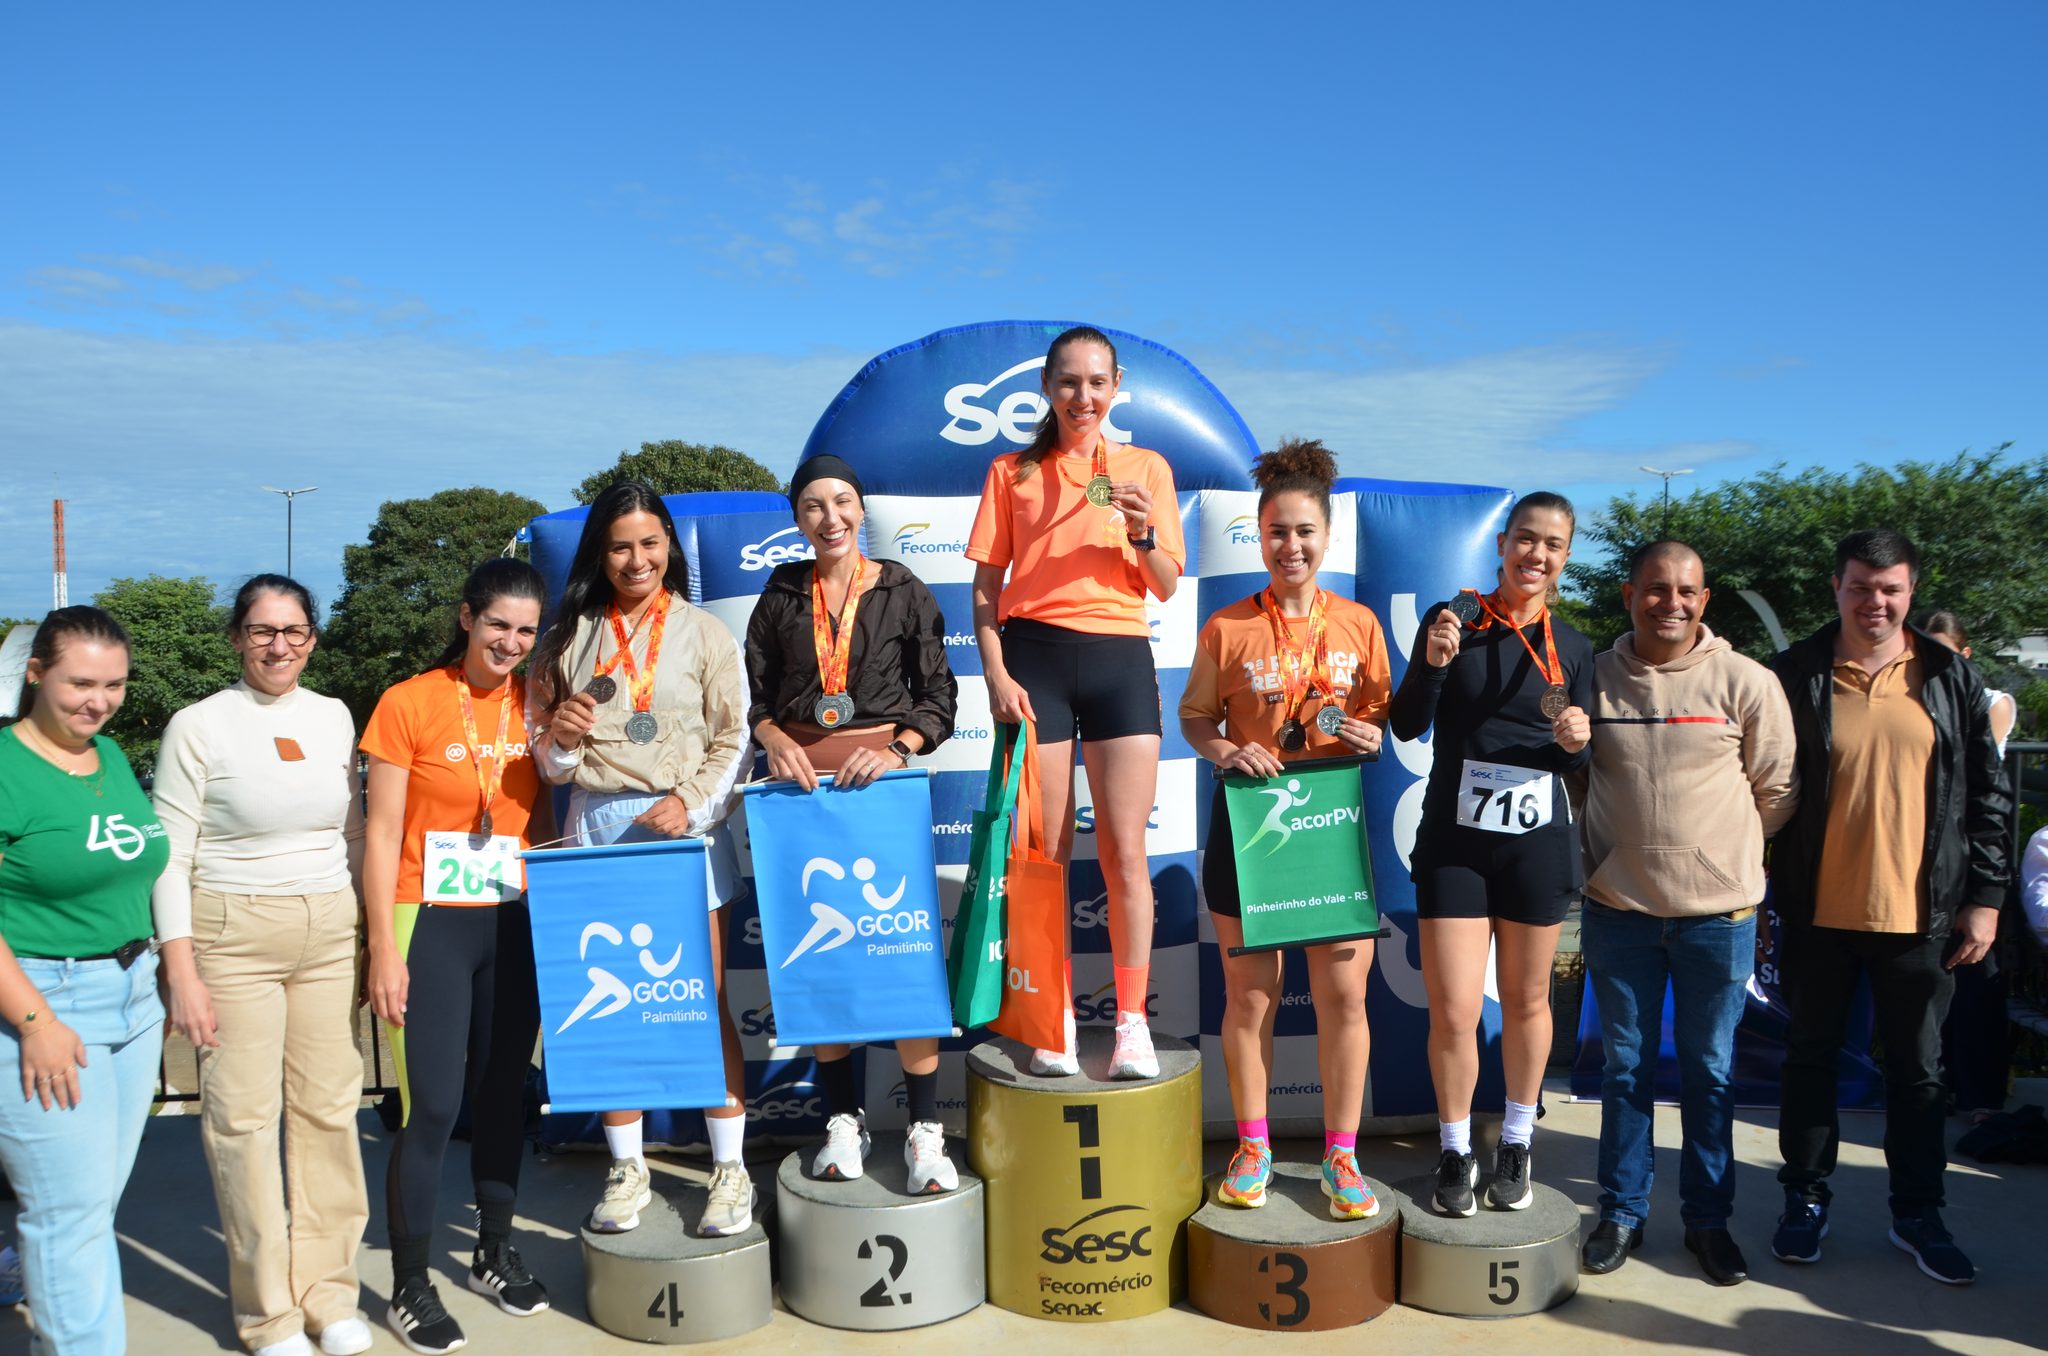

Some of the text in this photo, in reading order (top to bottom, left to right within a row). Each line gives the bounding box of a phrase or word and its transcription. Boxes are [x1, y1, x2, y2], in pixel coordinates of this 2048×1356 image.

[939, 383, 1132, 446] Sec
[901, 536, 967, 555] Fecomér
[1291, 806, 1361, 831] acorPV
[1472, 786, 1540, 829] 716
[86, 813, 146, 861] 45
[436, 857, 505, 896] 261
[1247, 898, 1307, 914] Pinheirinho
[1308, 896, 1322, 907] do
[1323, 892, 1346, 905] Vale
[1354, 890, 1369, 901] RS
[857, 910, 931, 937] GCOR
[867, 941, 934, 956] Palmitinho
[633, 978, 706, 1003] GCOR
[642, 1010, 708, 1024] Palmitinho
[1063, 1104, 1102, 1200] 1
[857, 1234, 912, 1307] 2
[1040, 1272, 1153, 1295] Fecomércio
[1488, 1260, 1519, 1306] 5
[648, 1282, 684, 1328] 4
[1258, 1252, 1310, 1327] 3
[1041, 1299, 1104, 1316] Senac
